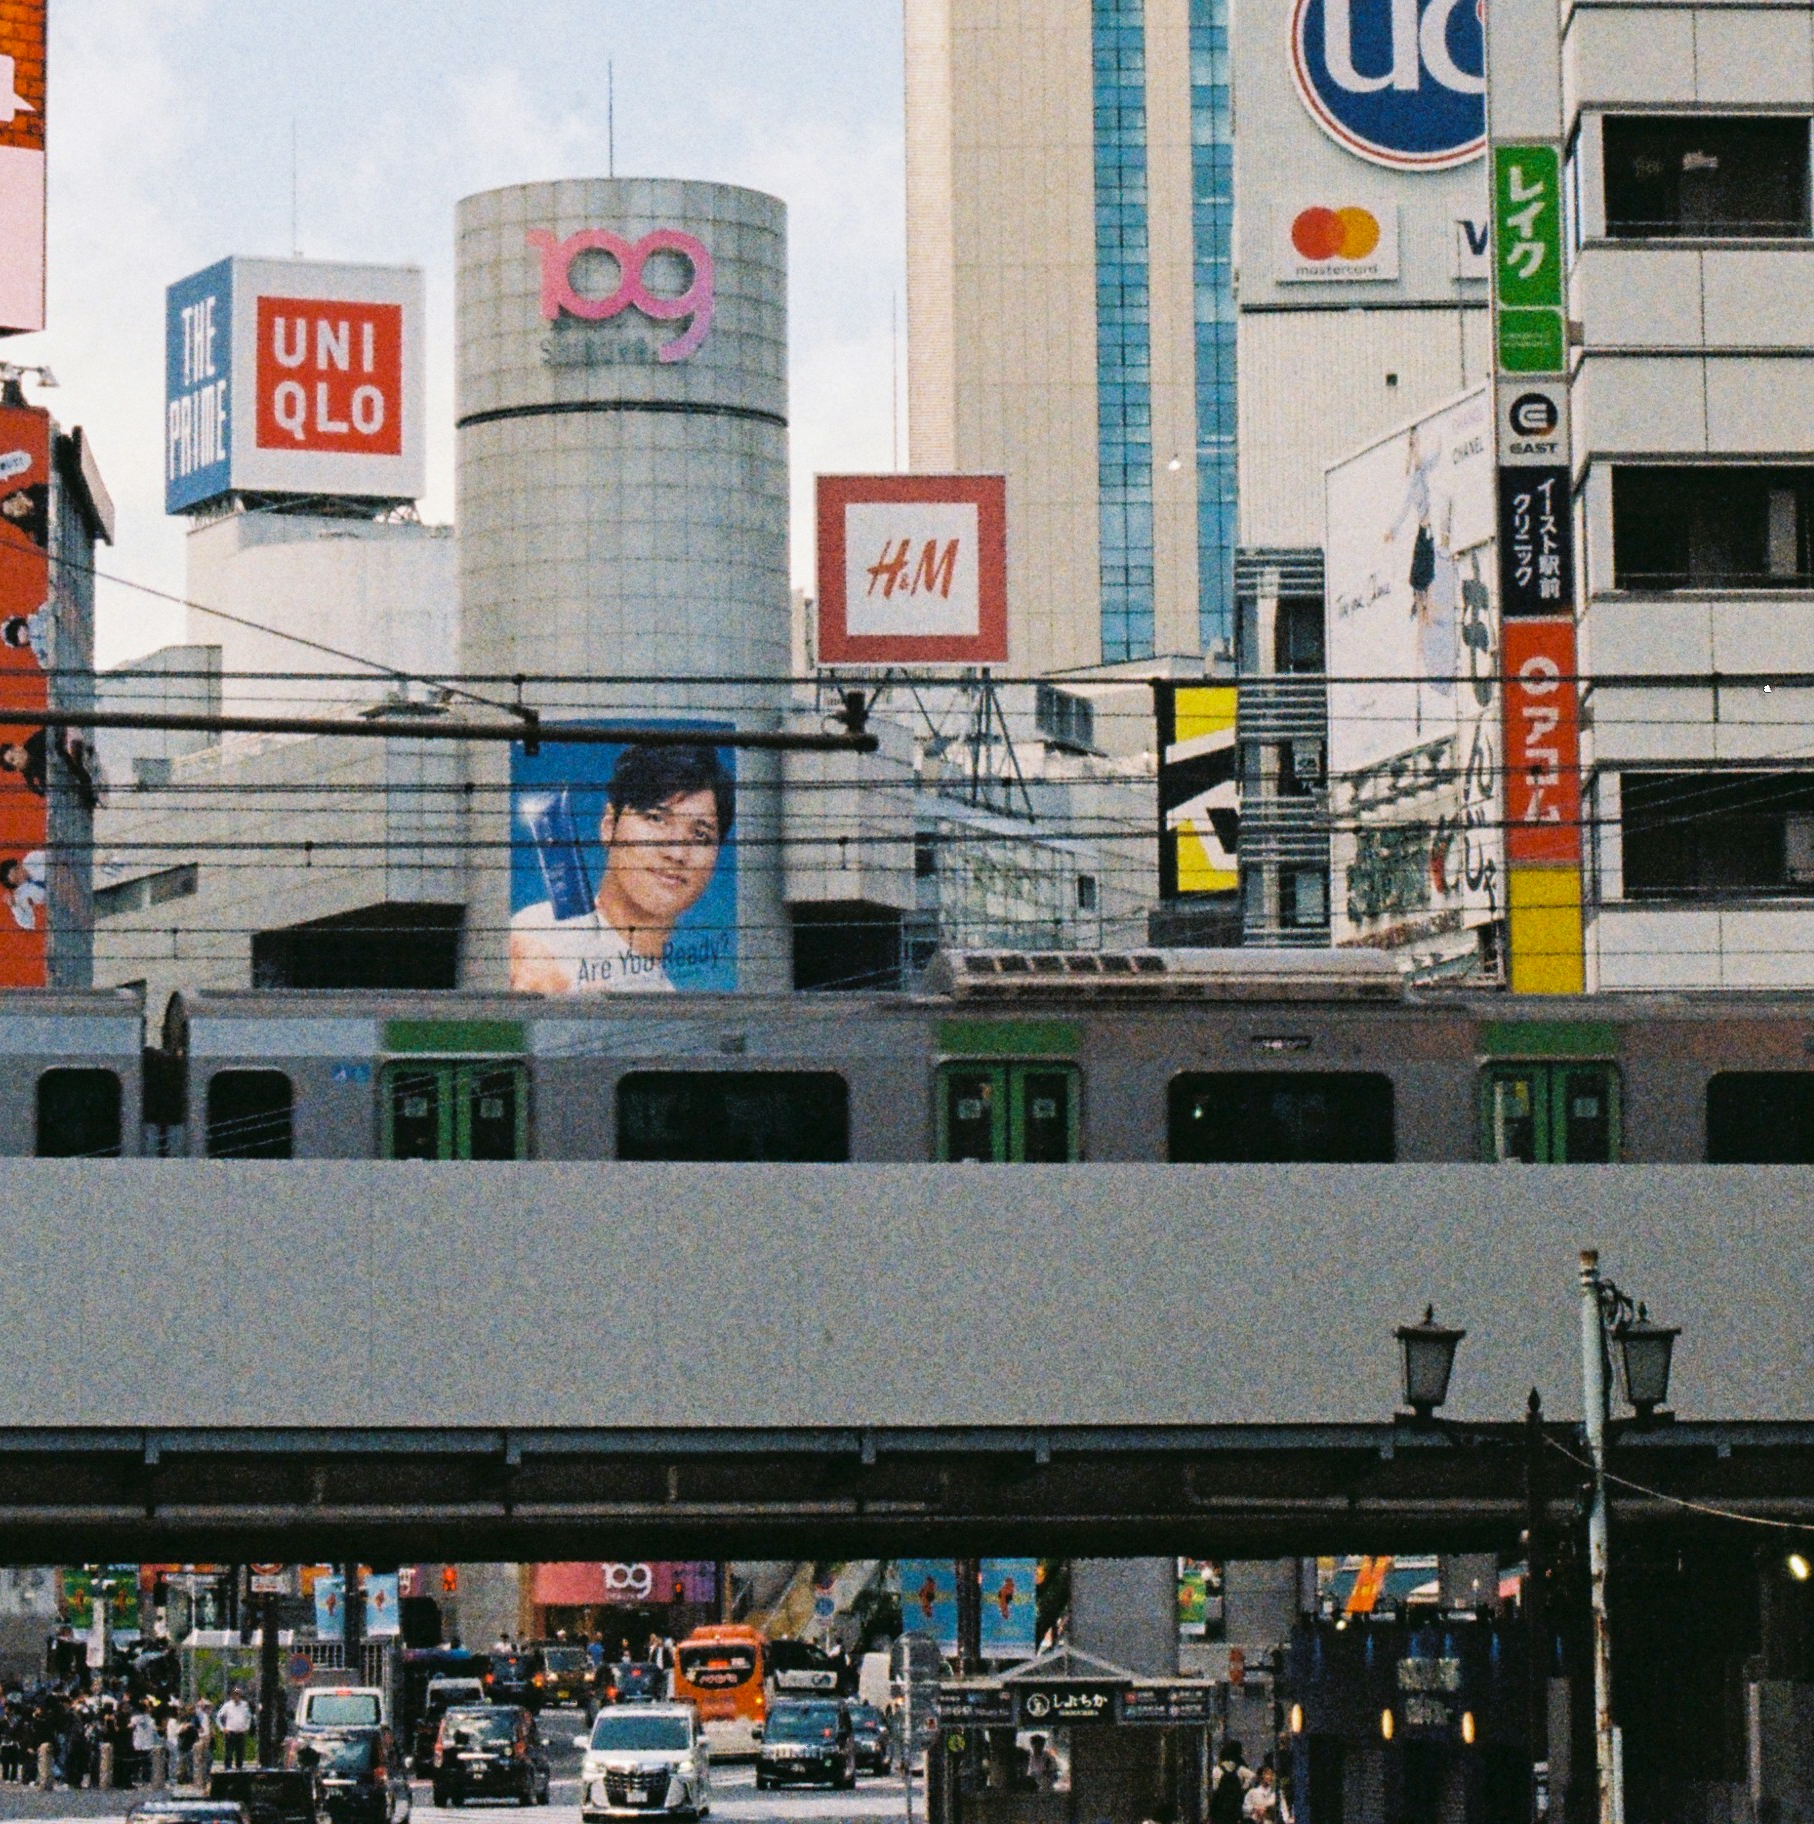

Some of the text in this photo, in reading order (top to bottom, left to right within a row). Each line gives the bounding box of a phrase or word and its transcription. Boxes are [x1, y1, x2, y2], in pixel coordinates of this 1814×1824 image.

[1506, 164, 1546, 280] レイク
[525, 227, 715, 364] 109
[1295, 263, 1379, 275] mastercard
[179, 294, 217, 383] THE
[273, 316, 375, 373] UNI
[167, 378, 231, 482] PRIME
[273, 380, 386, 441] QLO
[865, 536, 960, 601] H&M
[577, 932, 731, 984] Are You Ready?
[601, 1563, 653, 1600] 109
